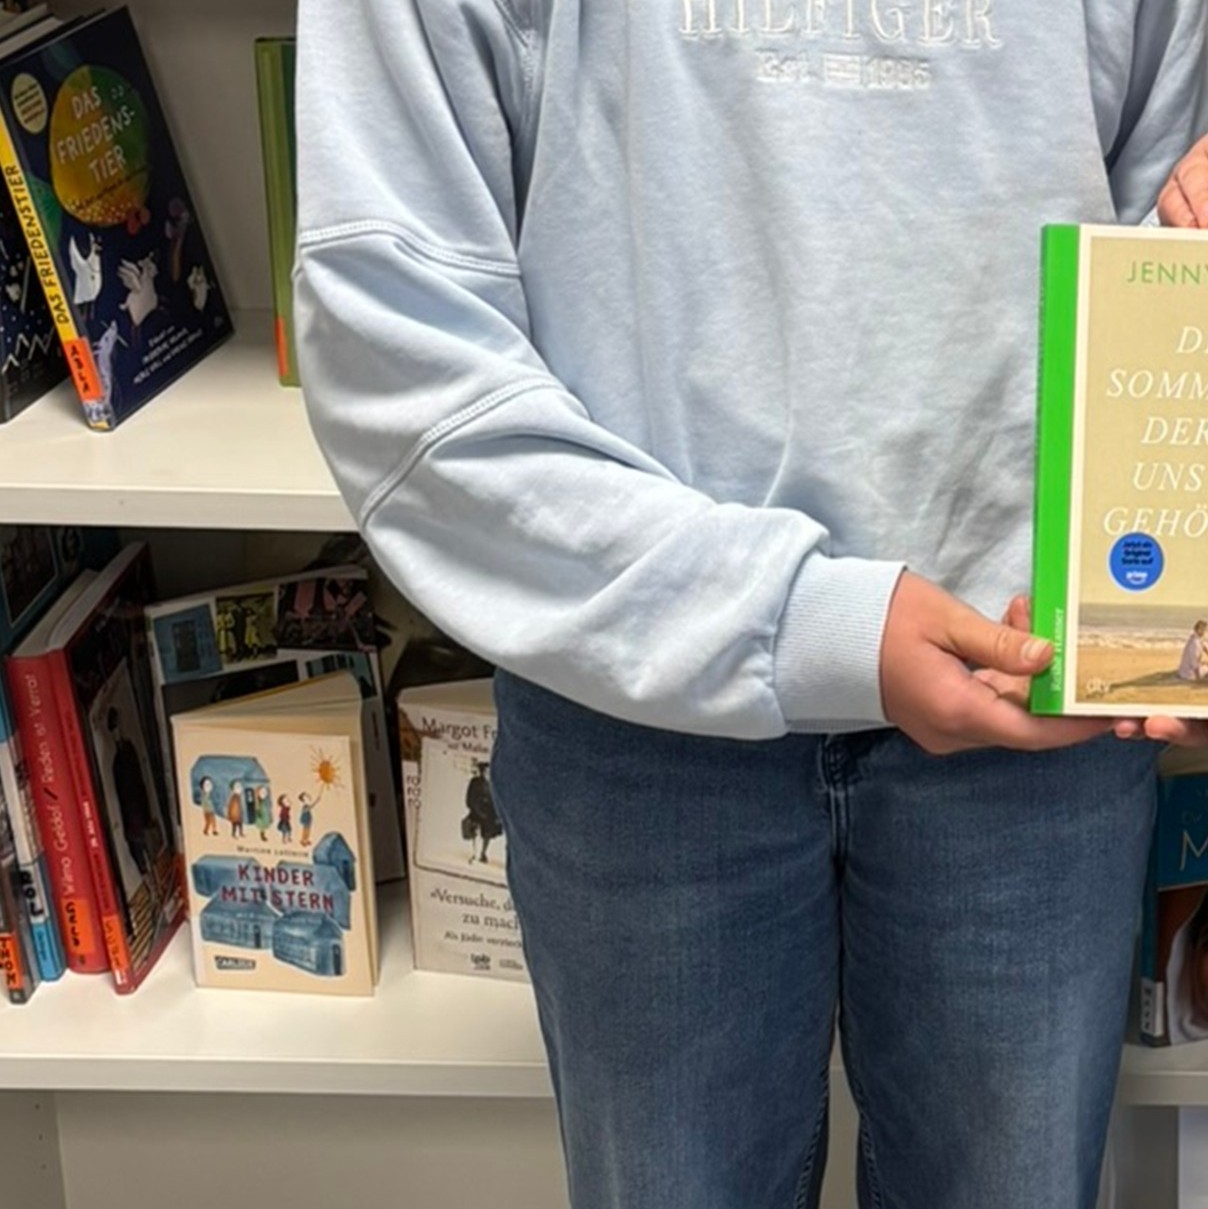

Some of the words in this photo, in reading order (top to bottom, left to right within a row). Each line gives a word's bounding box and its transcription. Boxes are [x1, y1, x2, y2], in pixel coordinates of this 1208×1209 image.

[71, 86, 102, 121] DAS
[56, 102, 136, 166] FRIEDENS-
[88, 146, 128, 184] TIER
[6, 165, 58, 294] FRIEDENSTIER
[54, 297, 70, 325] DAS
[1132, 462, 1205, 492] UNS
[422, 716, 478, 741] Margot
[238, 864, 315, 887] KINDER
[221, 886, 263, 904] MIT
[268, 891, 335, 912] STERN
[462, 914, 480, 927] zu
